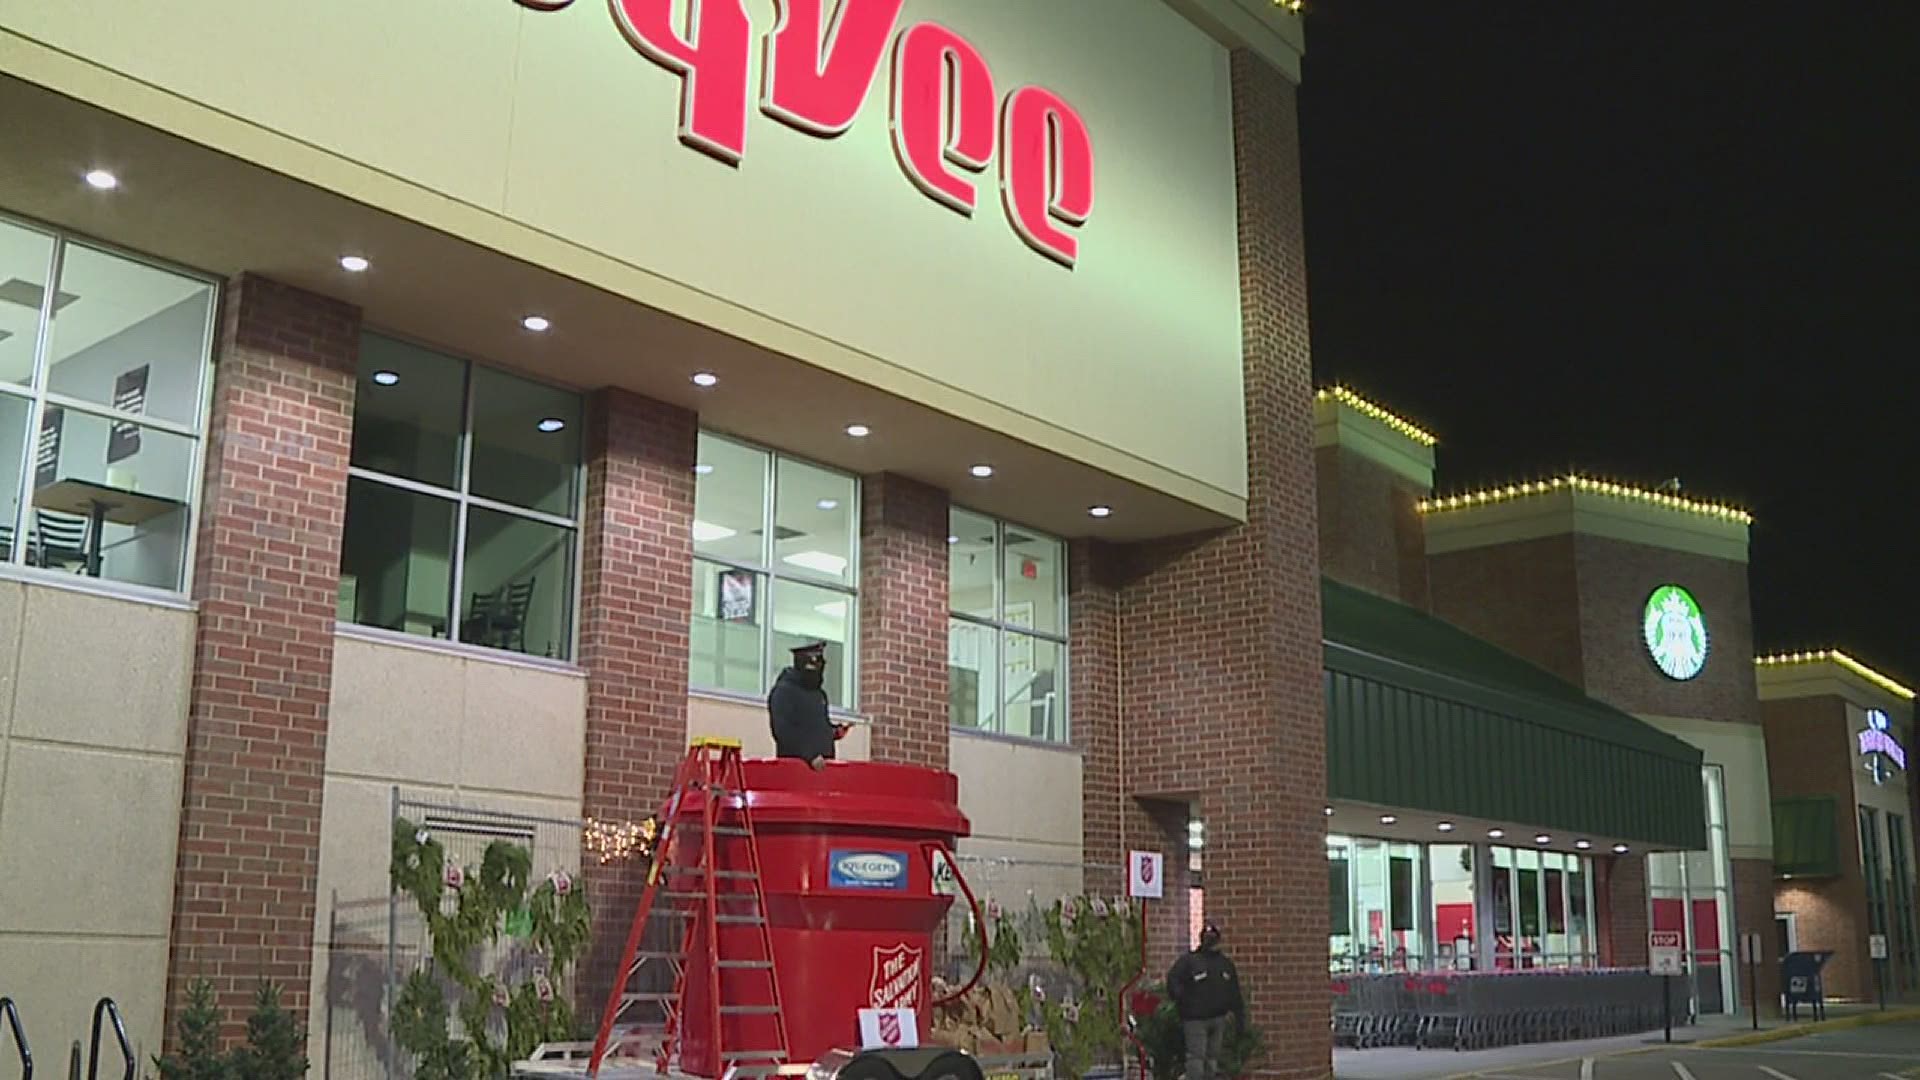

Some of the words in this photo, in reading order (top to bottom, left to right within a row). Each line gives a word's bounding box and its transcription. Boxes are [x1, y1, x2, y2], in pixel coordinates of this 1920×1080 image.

[512, 0, 1092, 265] yVee
[1652, 935, 1676, 946] STOP
[883, 951, 906, 980] THE
